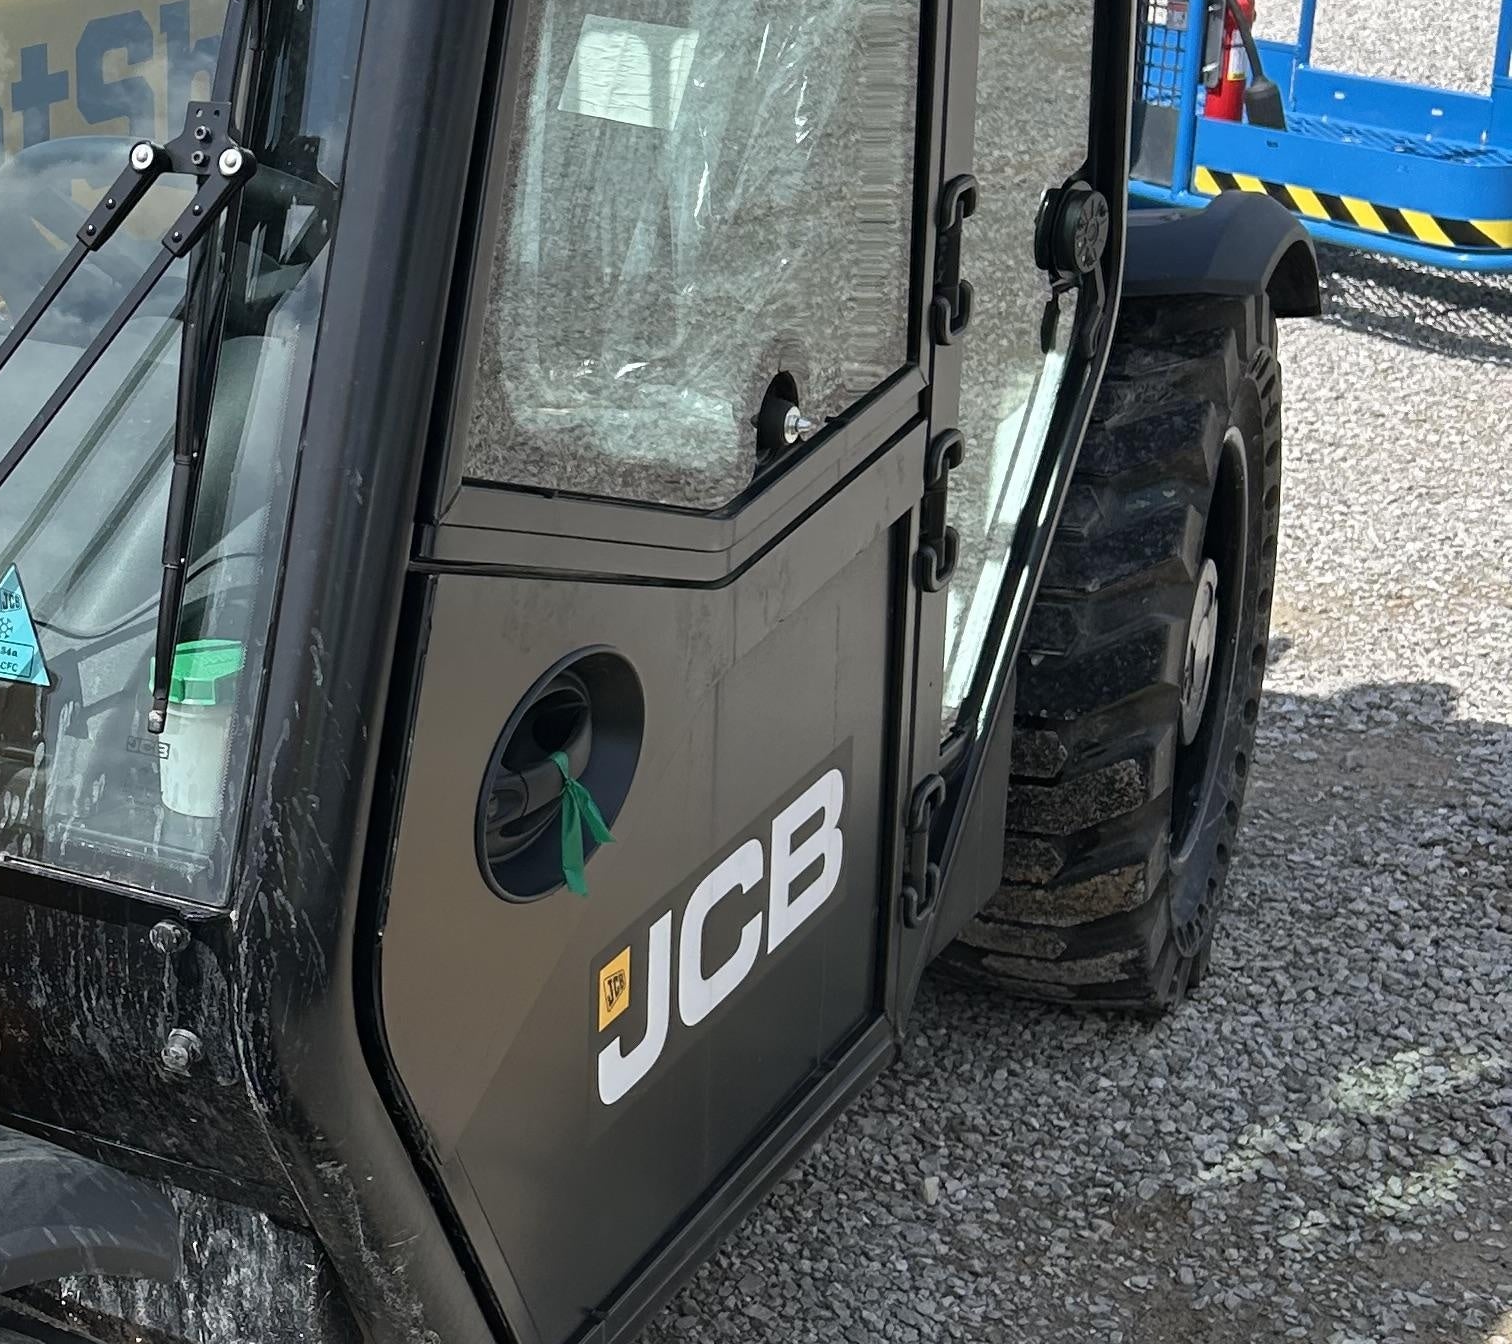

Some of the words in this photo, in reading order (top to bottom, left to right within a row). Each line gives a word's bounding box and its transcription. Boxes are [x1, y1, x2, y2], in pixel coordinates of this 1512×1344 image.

[1, 590, 22, 611] JCB
[598, 768, 843, 1105] JCB
[606, 972, 626, 1007] JCB
